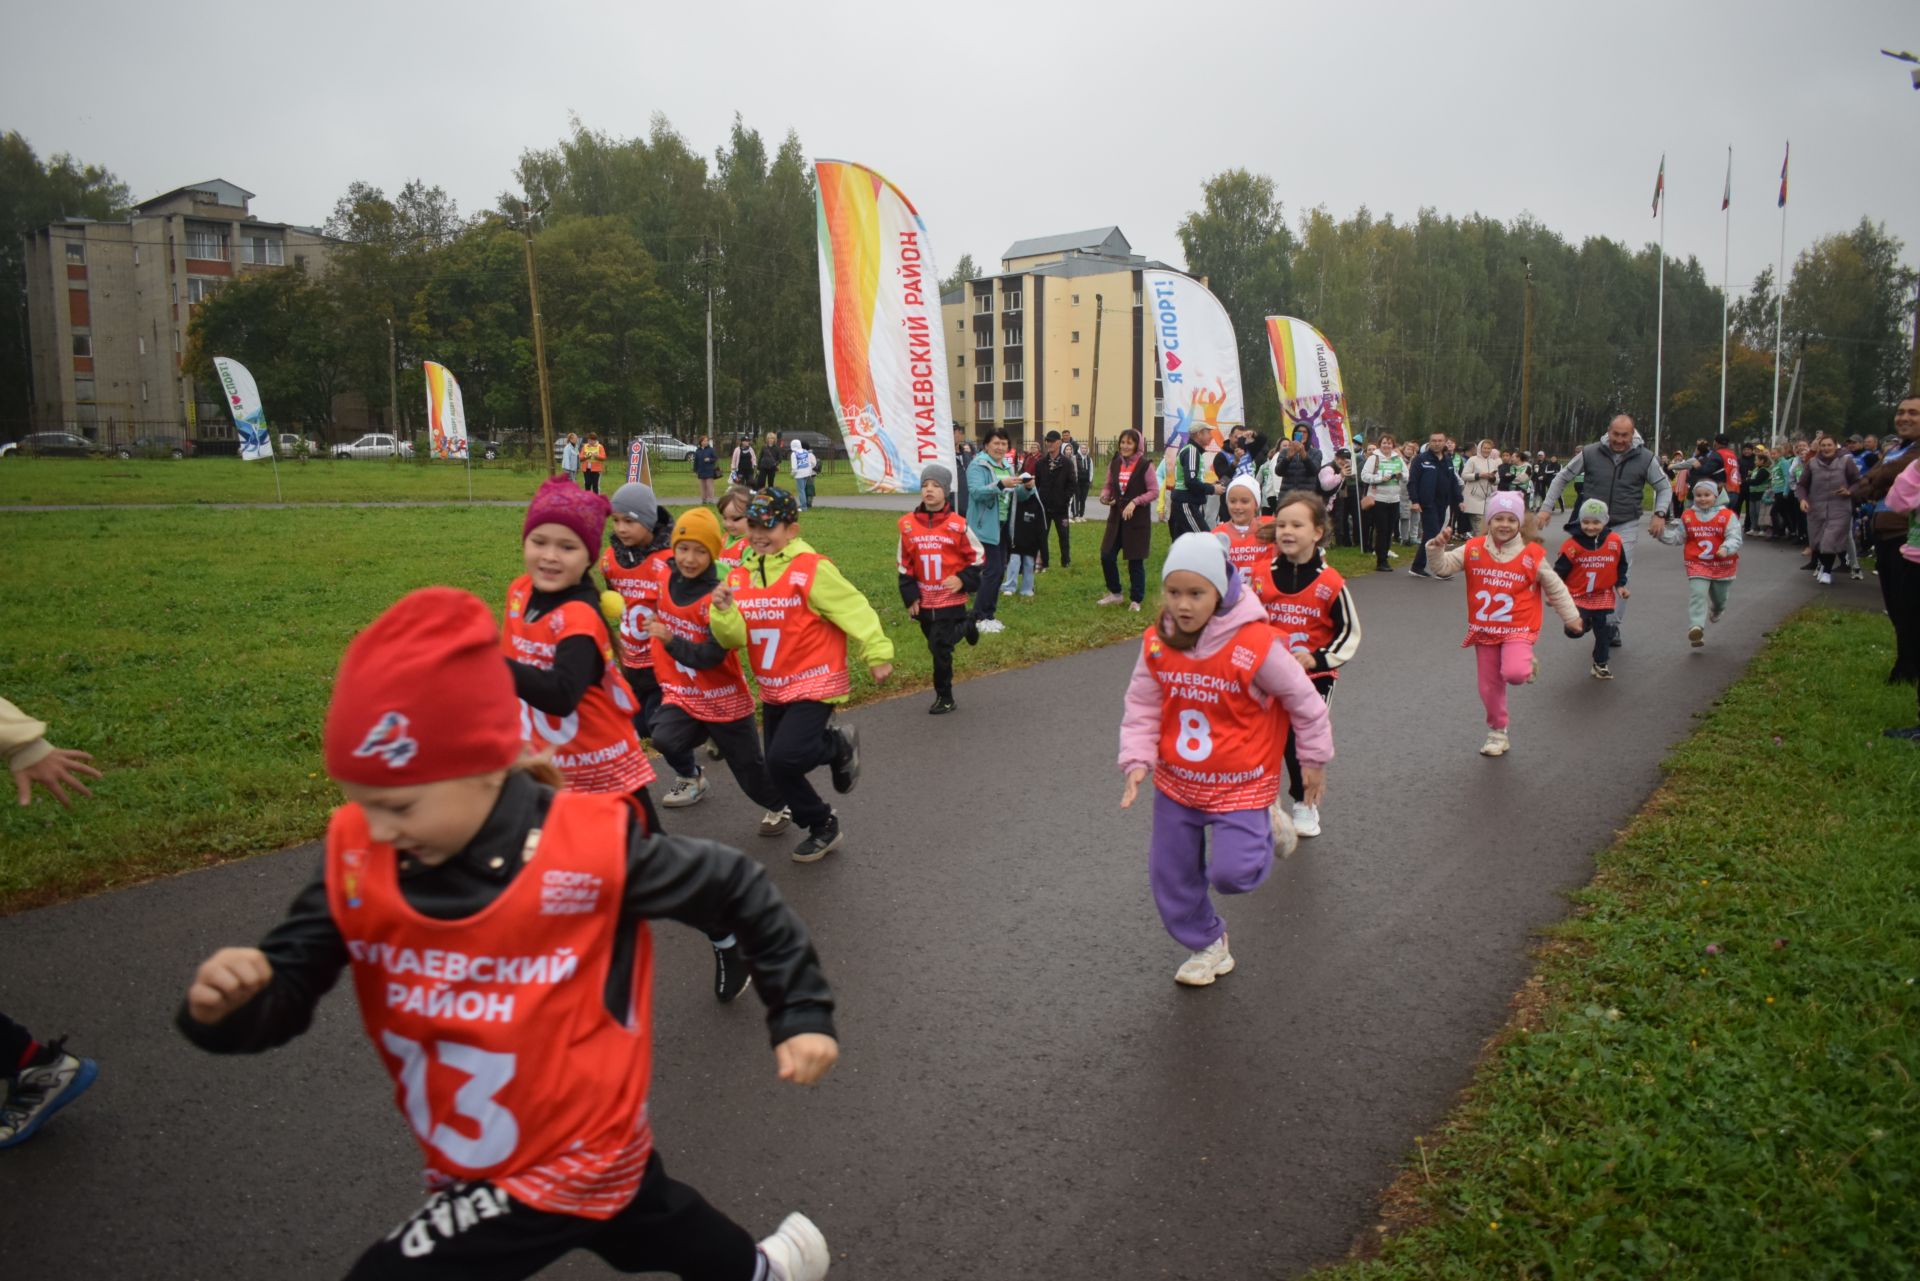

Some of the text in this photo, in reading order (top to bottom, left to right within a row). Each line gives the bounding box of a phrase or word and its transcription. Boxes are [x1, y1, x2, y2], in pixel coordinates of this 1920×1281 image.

[896, 231, 938, 463] ТУКАЕВСКИЙ РАЙОН
[1154, 281, 1183, 384] Я СПОРТ!
[1316, 343, 1329, 378] СПОРТА!
[218, 361, 238, 396] СПОРТ!
[628, 441, 641, 483] ФИНИ
[1229, 545, 1267, 554] АЕВСКИЙ
[1698, 540, 1714, 560] 2
[920, 554, 942, 581] 11
[1483, 577, 1513, 589] РАЙОН
[735, 594, 802, 608] УКАЕВСКИЙ
[744, 609, 785, 620] РАЙОН
[1475, 590, 1514, 622] 22
[1270, 611, 1307, 626] РАЙОН
[750, 628, 781, 670] 7
[1170, 685, 1219, 703] РАЙОН
[1175, 709, 1213, 762] 8
[576, 739, 629, 768] ЖИЗНИ
[1218, 764, 1265, 784] ЖИЗНИ
[385, 982, 515, 1023] РАЙОН
